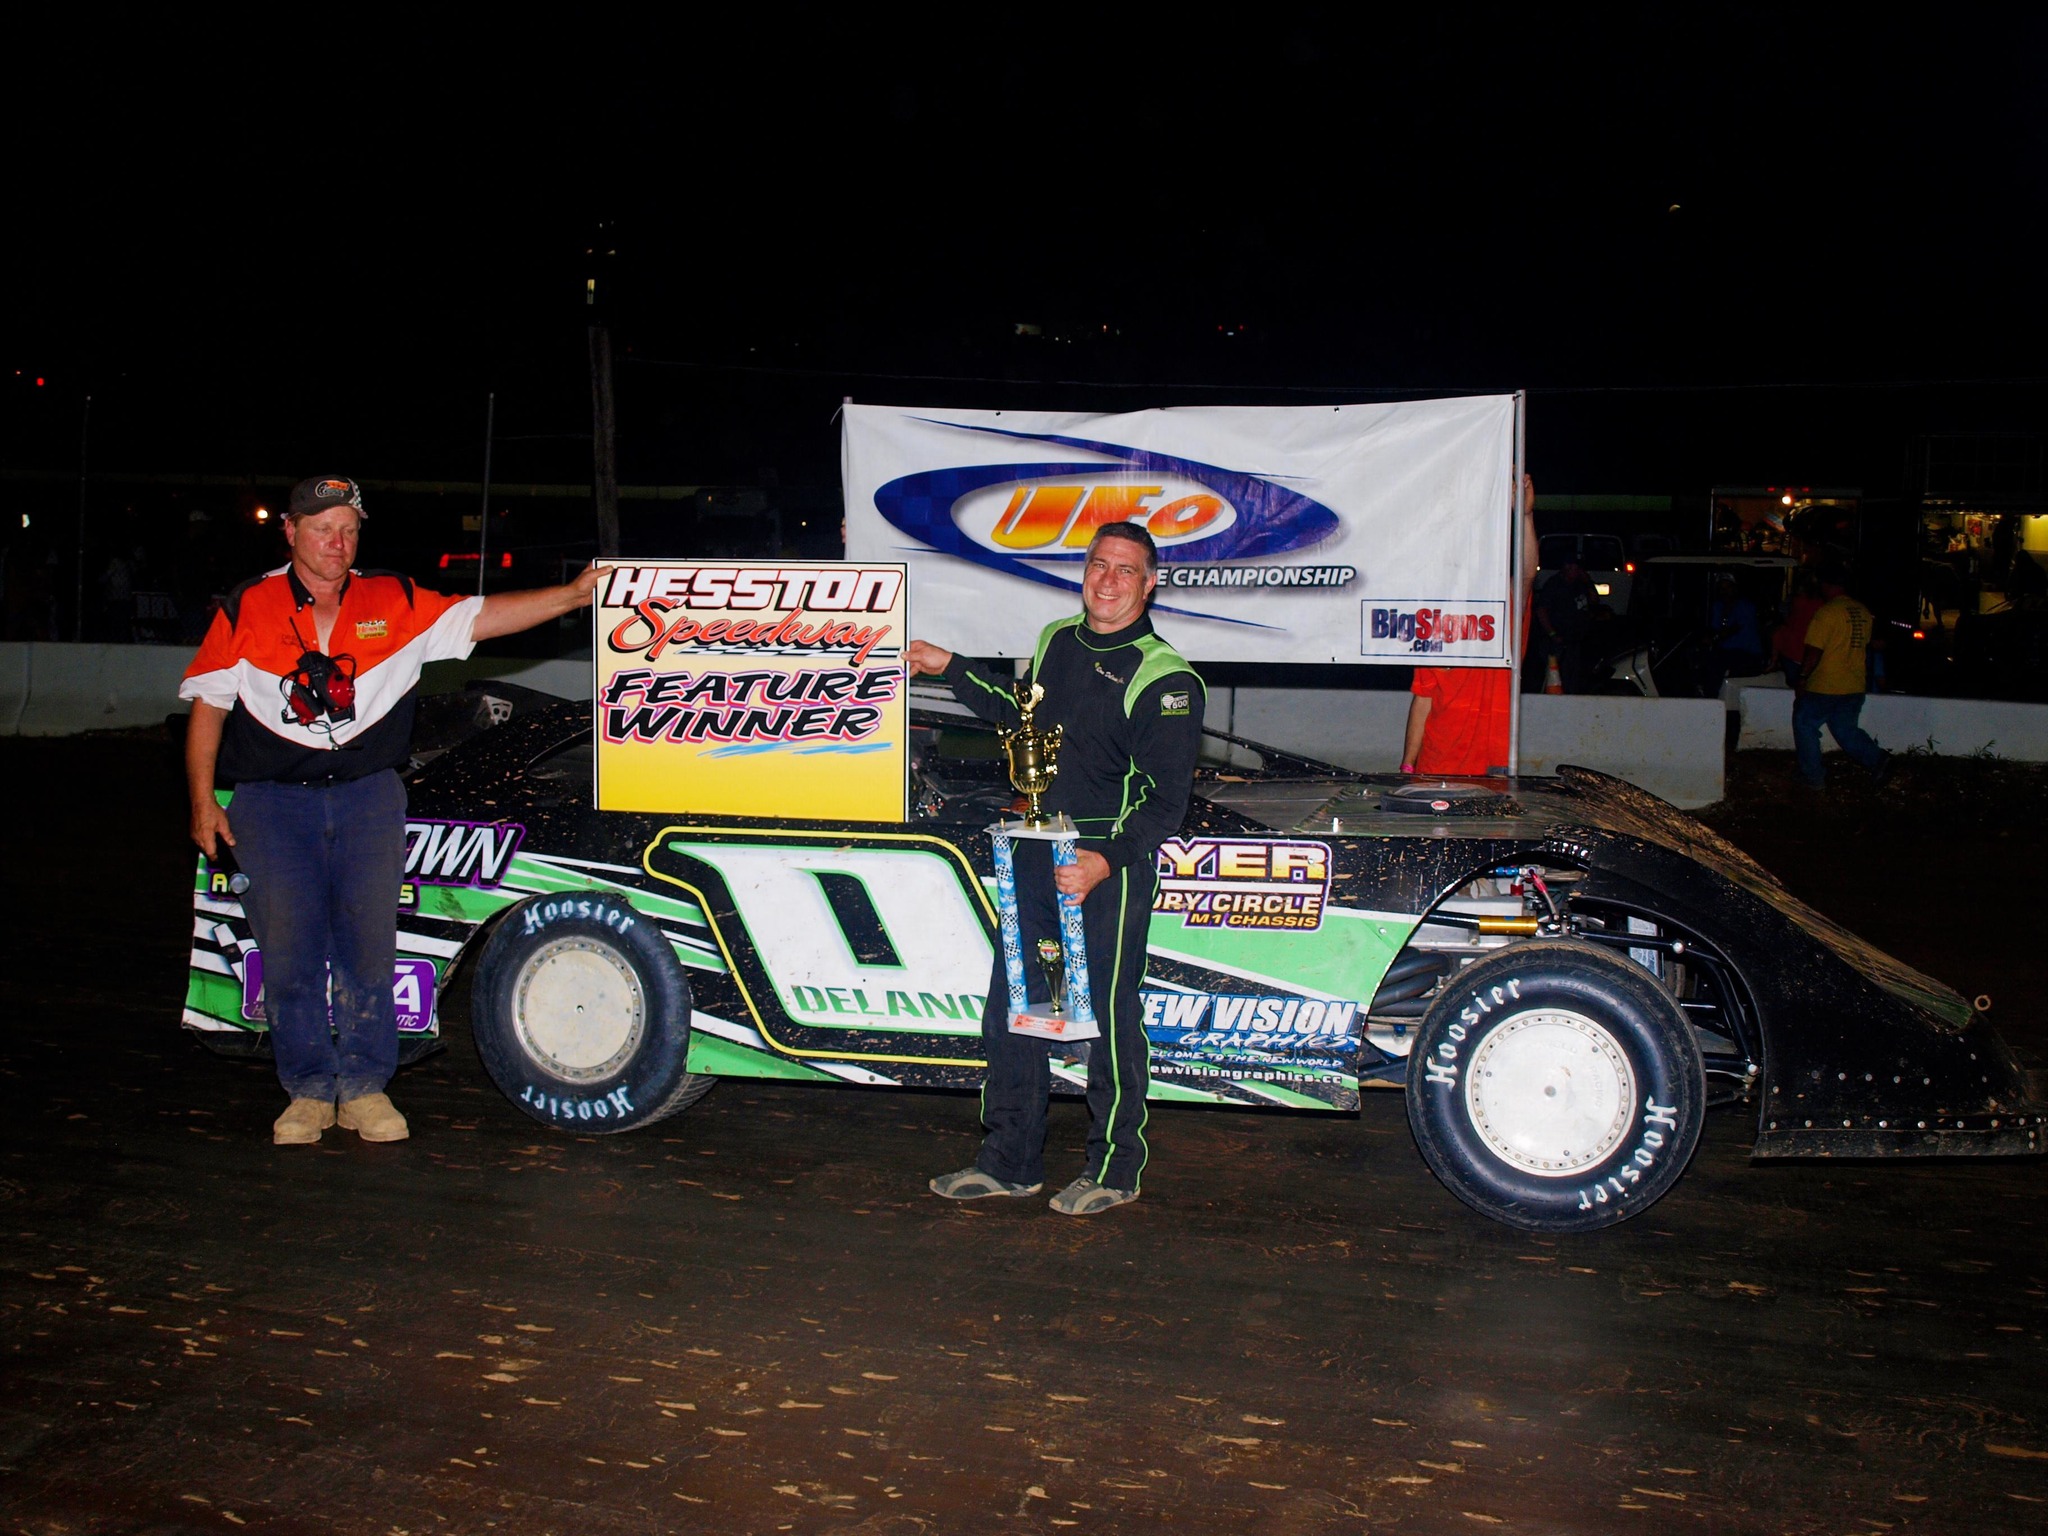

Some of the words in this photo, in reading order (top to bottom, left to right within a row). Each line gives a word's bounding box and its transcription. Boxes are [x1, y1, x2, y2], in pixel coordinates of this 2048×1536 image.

[601, 567, 904, 612] HESSTON
[1172, 567, 1355, 587] CHAMPIONSHIP
[608, 597, 891, 667] Speedway
[1371, 608, 1495, 643] BigSigns
[1409, 640, 1443, 652] .com
[602, 668, 905, 706] FEATURE
[603, 706, 882, 744] WINNER
[404, 823, 516, 880] OWN
[1160, 843, 1327, 879] YER
[522, 899, 635, 935] Hoosier
[1190, 913, 1221, 925] M1
[1228, 914, 1319, 927] CHASSIS
[1212, 891, 1321, 915] CIRCLE
[1213, 995, 1356, 1035] VISION
[1179, 1030, 1350, 1049] GRAPHICS
[1425, 978, 1521, 1092] Hoosier
[1150, 1049, 1204, 1060] ELCOME
[1207, 1053, 1224, 1061] TO
[1227, 1054, 1262, 1063] THE
[1262, 1056, 1294, 1065] NEW
[1296, 1058, 1344, 1068] WORLD
[1150, 1065, 1343, 1084] ewvisiongraphics.cc
[520, 1085, 635, 1121] Hoosier
[1578, 1095, 1678, 1210] Hoosier
